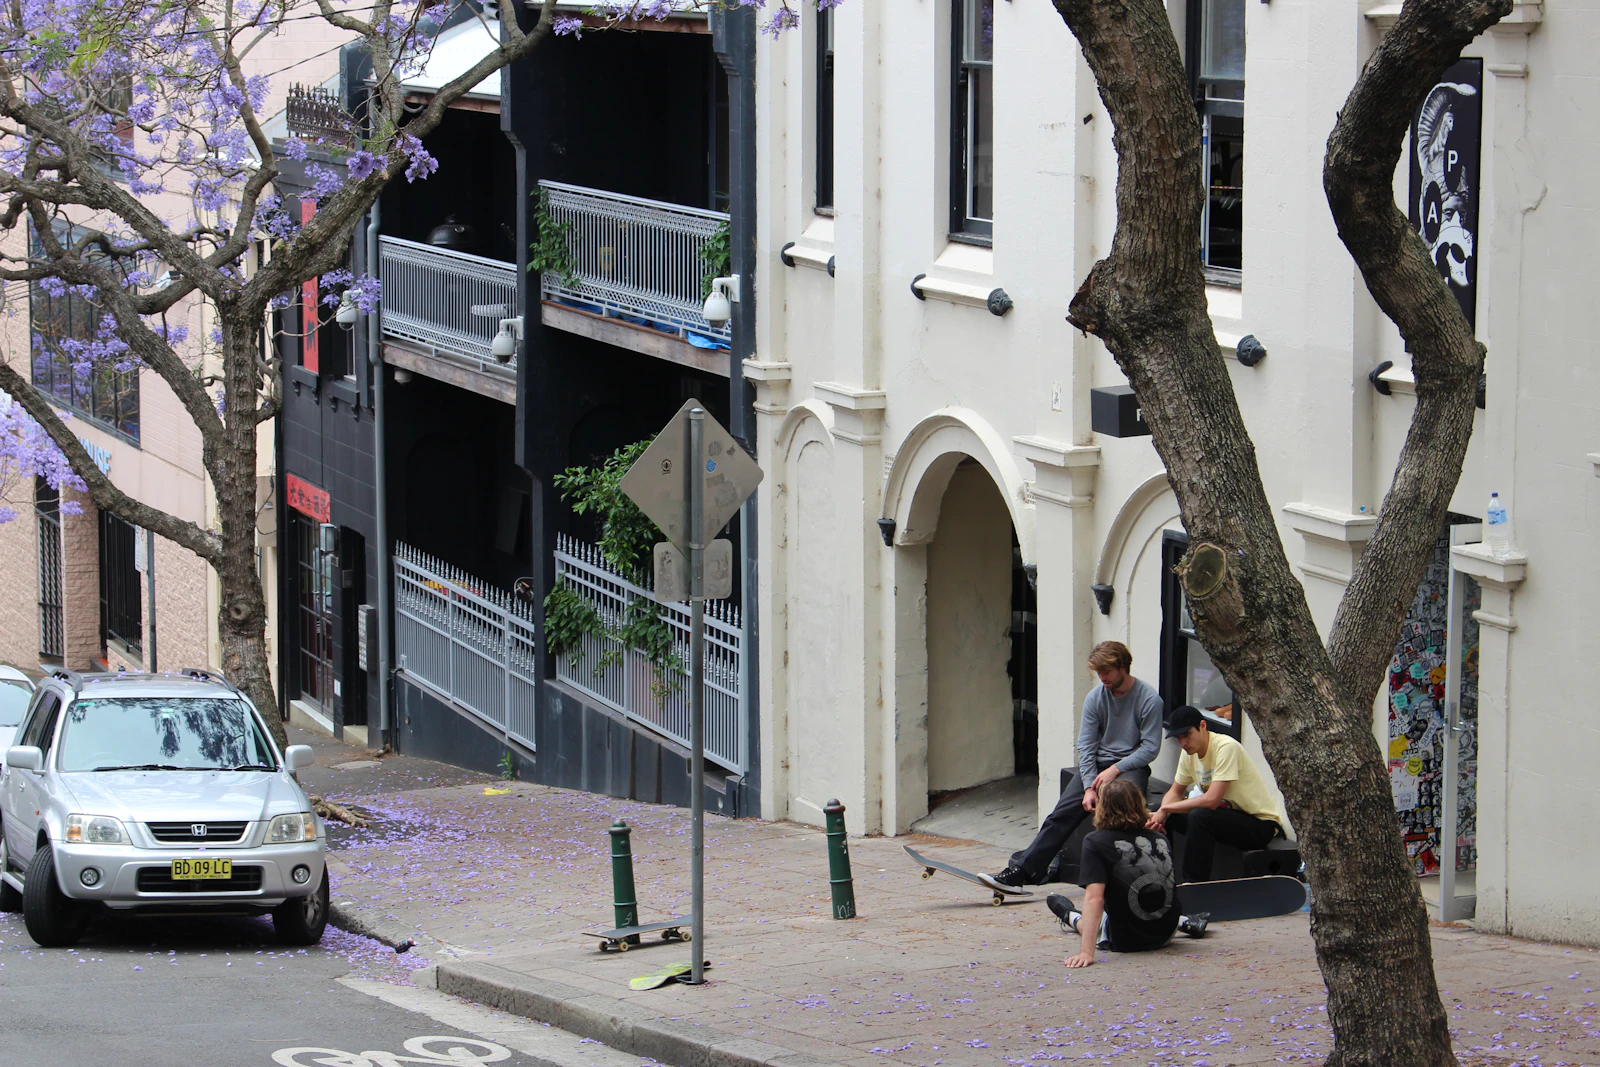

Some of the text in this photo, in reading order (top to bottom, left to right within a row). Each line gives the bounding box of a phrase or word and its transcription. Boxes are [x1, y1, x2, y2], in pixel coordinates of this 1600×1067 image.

[1447, 150, 1458, 172] P
[1427, 201, 1439, 224] A
[77, 436, 111, 476] OUSE
[1421, 721, 1437, 746] SUPPLY
